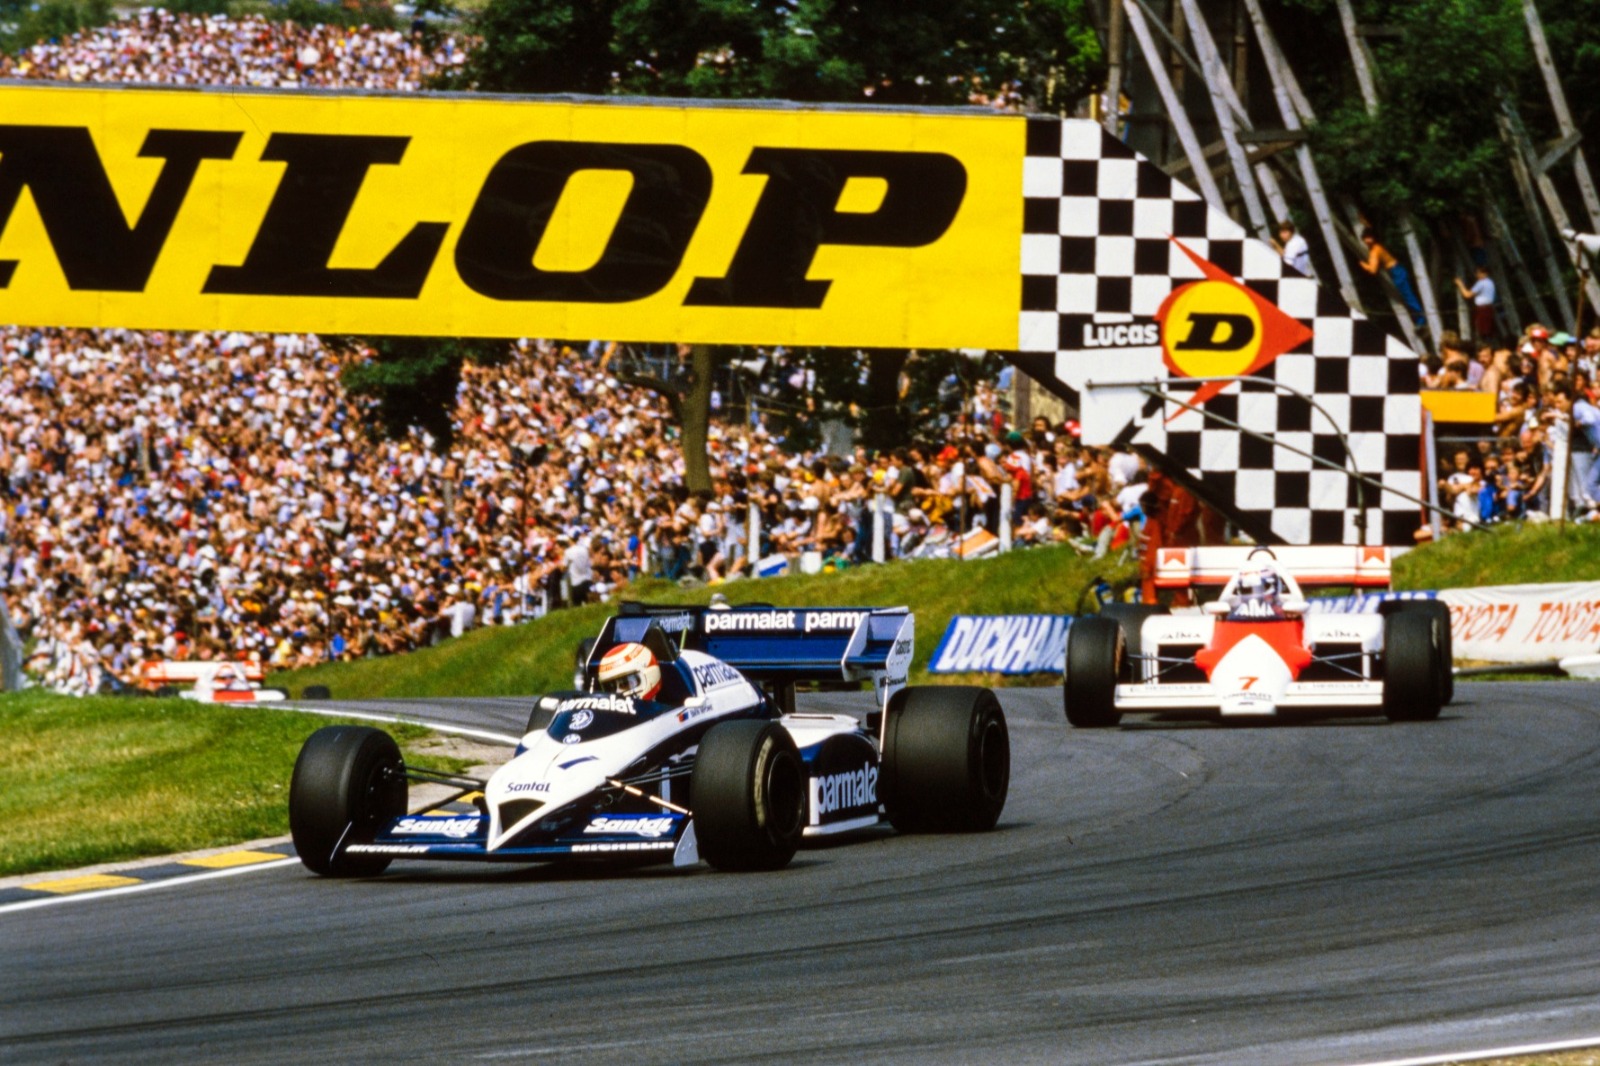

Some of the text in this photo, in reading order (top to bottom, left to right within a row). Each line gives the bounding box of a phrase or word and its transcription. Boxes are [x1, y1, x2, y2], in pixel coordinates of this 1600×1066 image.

[1083, 322, 1160, 347] Lucas
[1173, 312, 1256, 352] D
[705, 610, 796, 633] parmalat
[1451, 604, 1518, 642] OYOTA
[1238, 676, 1260, 691] 7
[504, 781, 552, 794] Santal
[809, 760, 878, 826] parmala
[390, 818, 481, 839] Santal
[582, 817, 673, 838] Santal
[571, 842, 675, 853] MICHELIN
